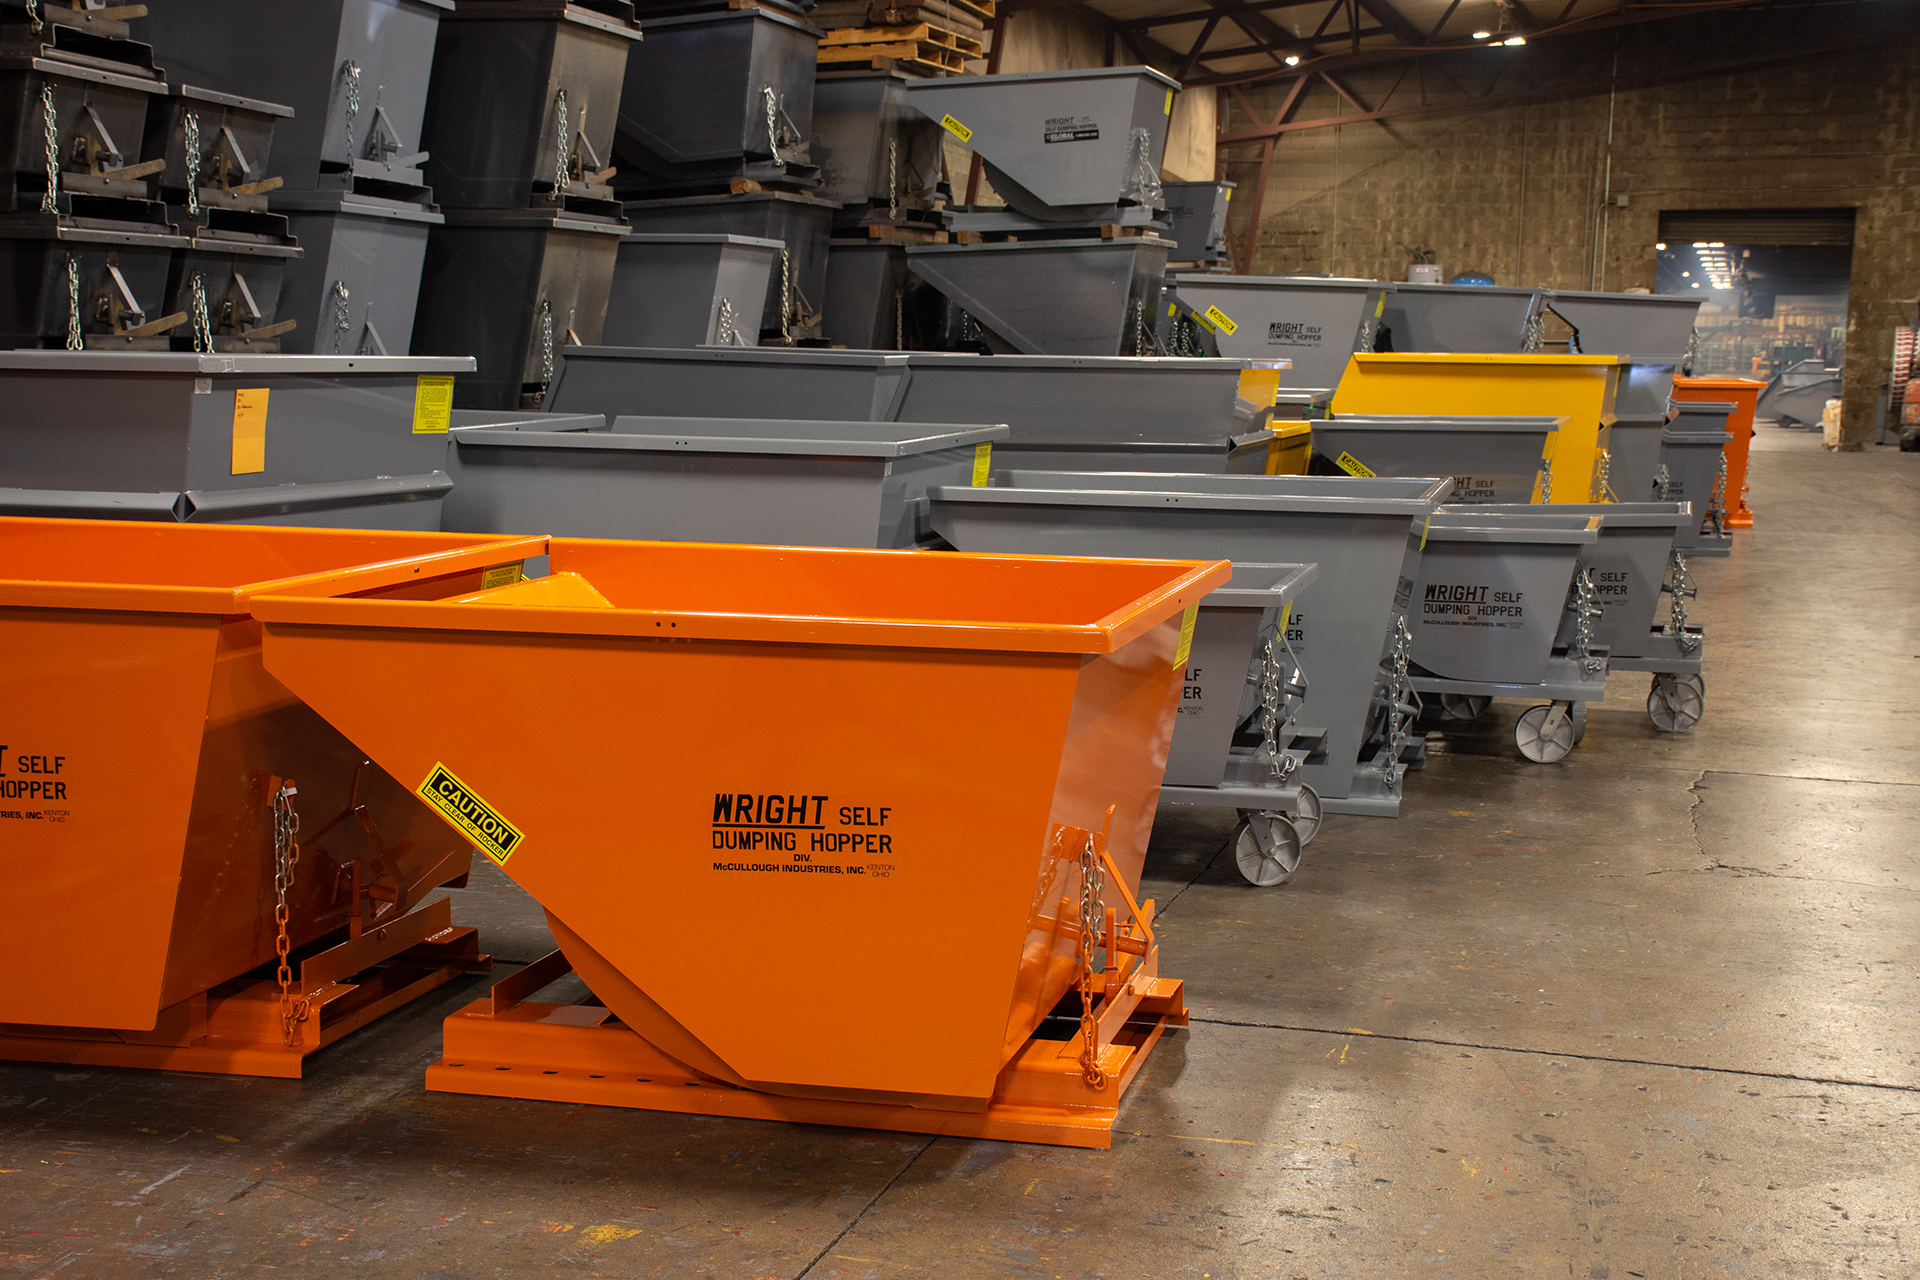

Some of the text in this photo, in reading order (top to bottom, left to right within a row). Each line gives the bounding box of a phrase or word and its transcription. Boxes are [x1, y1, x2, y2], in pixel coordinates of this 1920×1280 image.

[1045, 117, 1074, 126] WRIGHT
[1269, 322, 1304, 332] WRIGHT
[1475, 480, 1495, 488] SELF
[1600, 572, 1628, 582] SELF
[1424, 584, 1489, 602] WRIGHT
[1494, 592, 1523, 603] SELF
[1424, 603, 1523, 617] DUMPING HOPPER
[1288, 614, 1303, 625] LF
[1184, 668, 1202, 681] LF
[18, 755, 65, 774] SELF
[439, 780, 509, 844] CAUTION
[712, 794, 892, 826] WRIGHT SELF
[426, 788, 504, 856] STAY CLEAR OF ROCKER
[712, 830, 892, 854] DUMPING HOPPER
[794, 854, 812, 862] DIV.
[713, 862, 866, 875] McCULLOUGH INDUSTRIES, INC.
